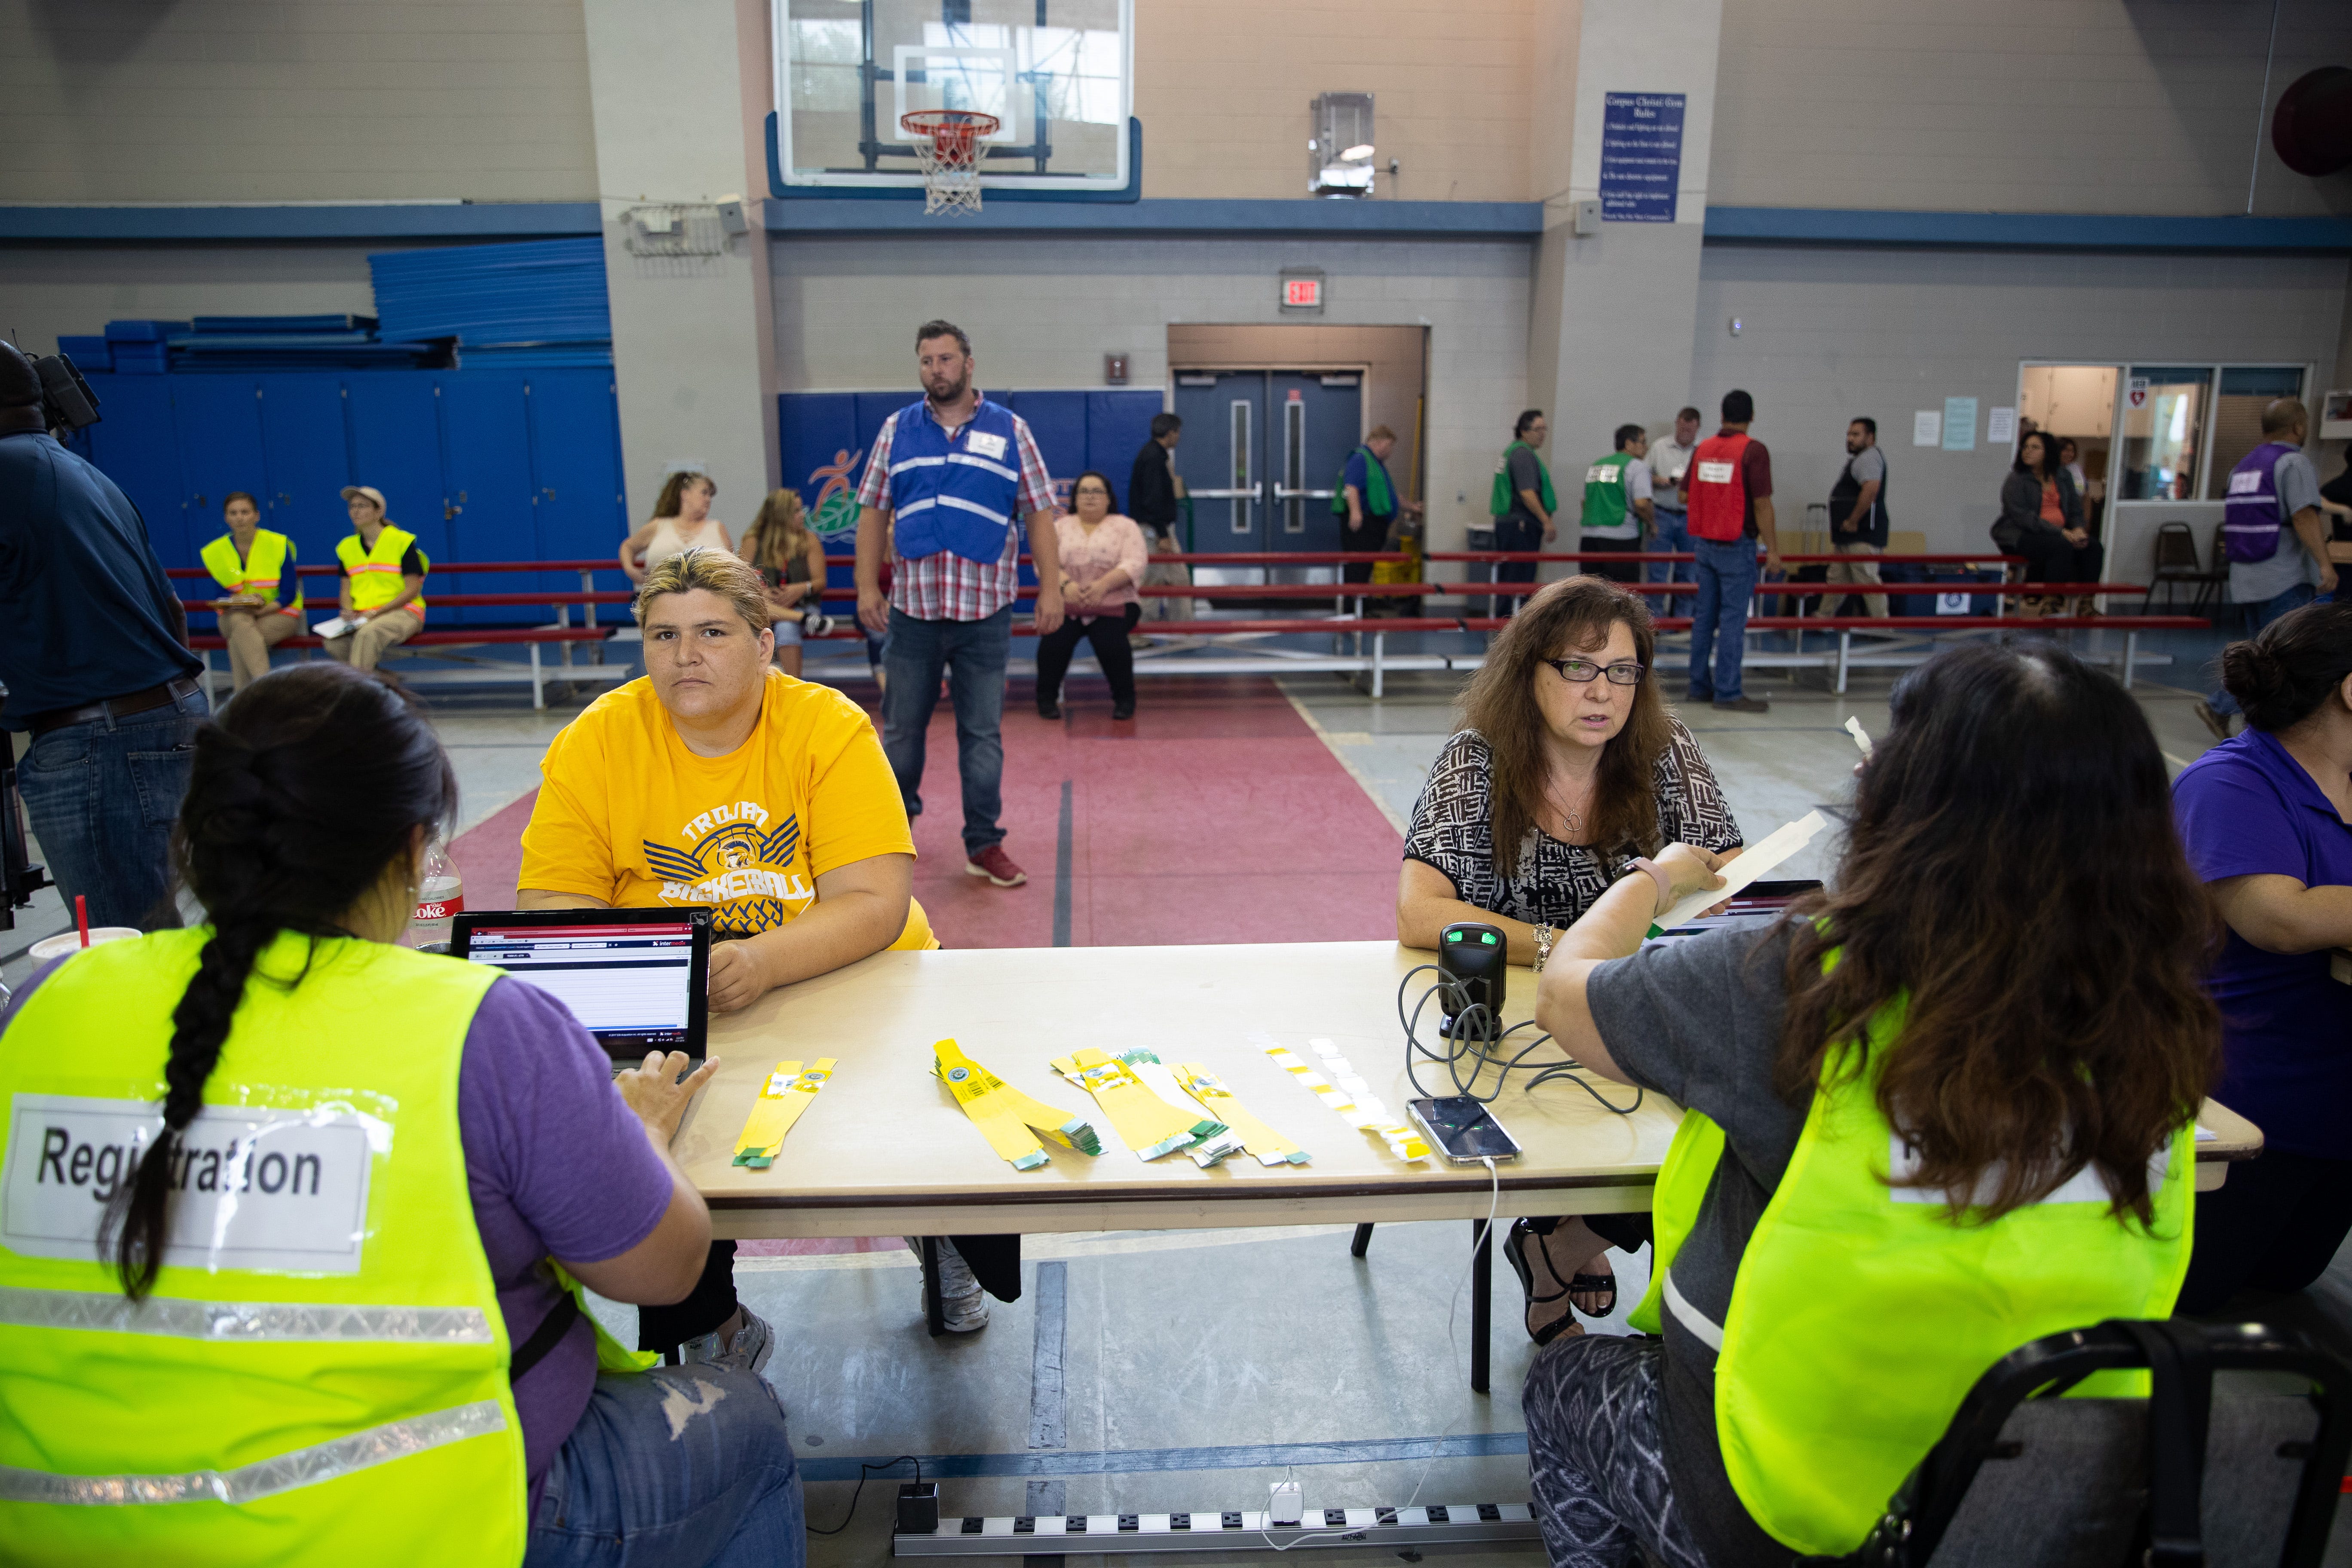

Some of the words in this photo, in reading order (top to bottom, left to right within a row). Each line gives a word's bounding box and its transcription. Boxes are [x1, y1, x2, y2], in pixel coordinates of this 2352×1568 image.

[1607, 95, 1635, 108] Corpus
[1636, 96, 1664, 107] Christi
[1634, 107, 1656, 118] Rules
[1289, 281, 1316, 304] EXIT
[681, 801, 769, 841] TROJAN
[413, 905, 445, 918] oke
